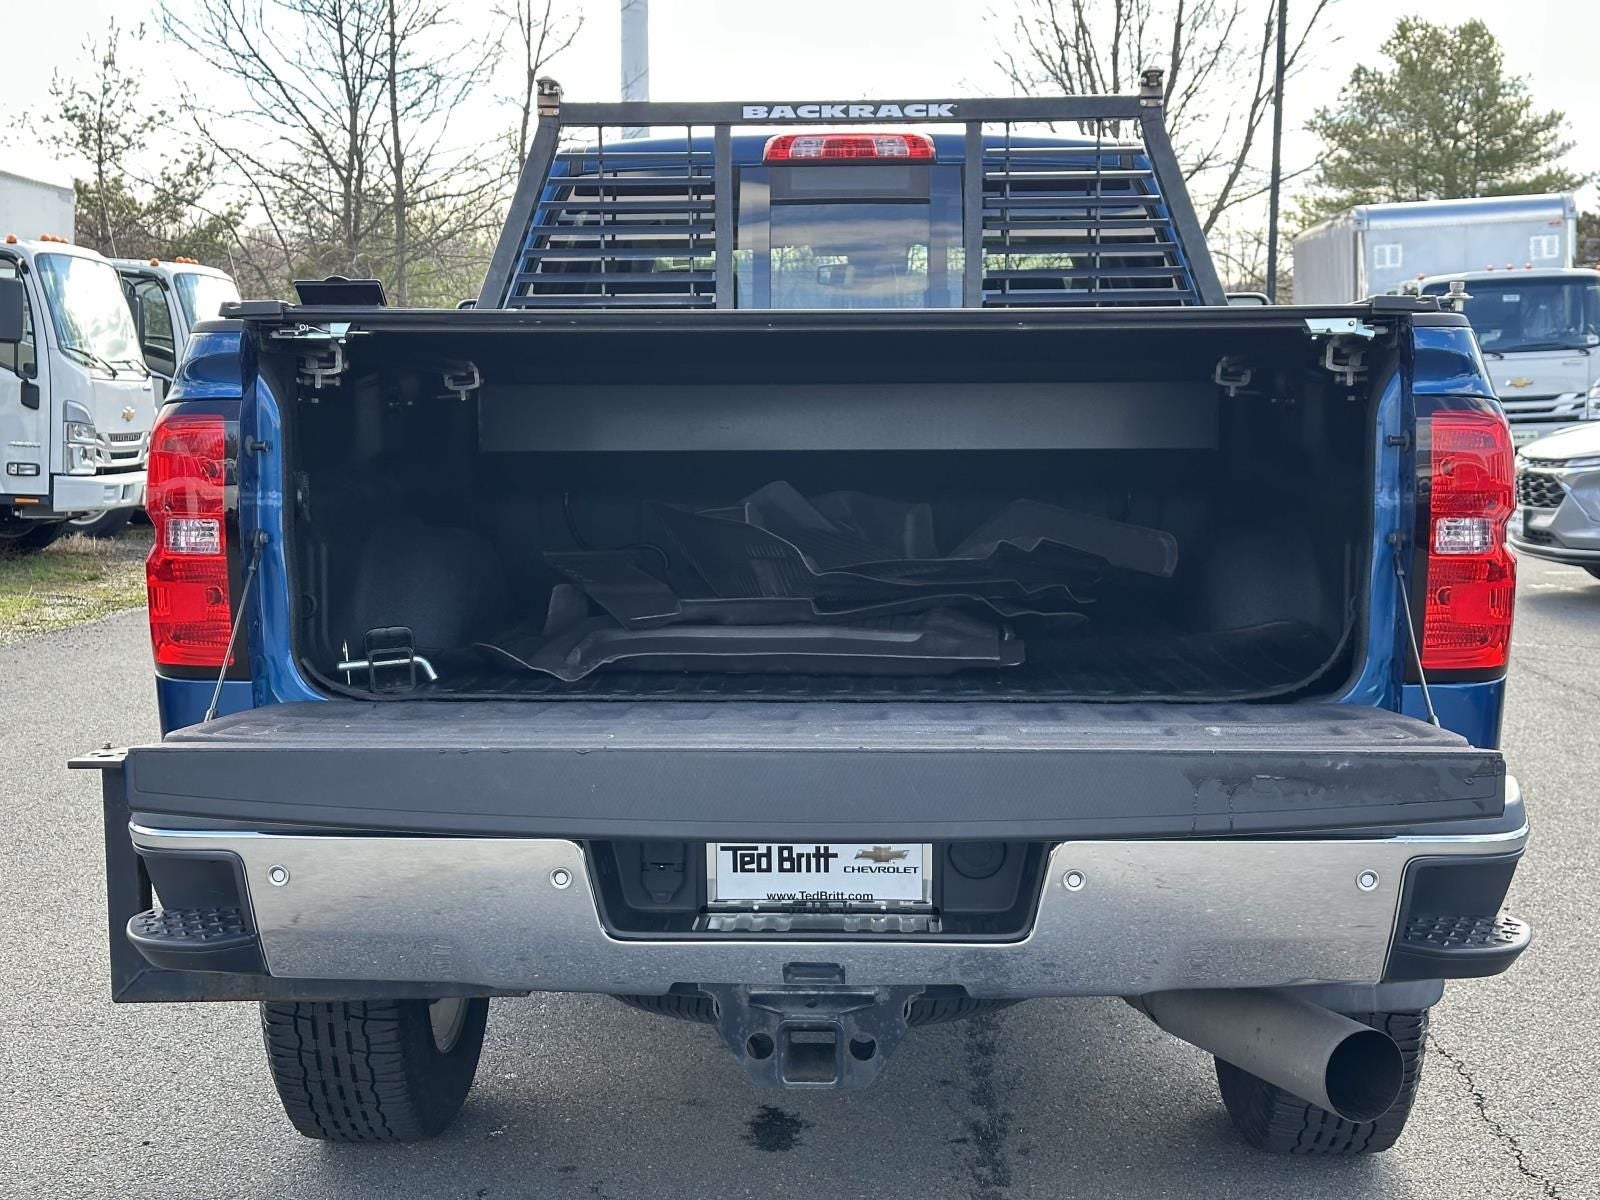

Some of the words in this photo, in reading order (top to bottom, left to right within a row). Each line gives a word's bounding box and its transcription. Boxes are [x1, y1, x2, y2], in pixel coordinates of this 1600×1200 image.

[742, 103, 955, 119] BACKRACK
[720, 845, 772, 873] Ted
[778, 845, 838, 873] Britt
[843, 865, 919, 874] CHEVROLET
[766, 891, 874, 901] www.TedBritt.com
